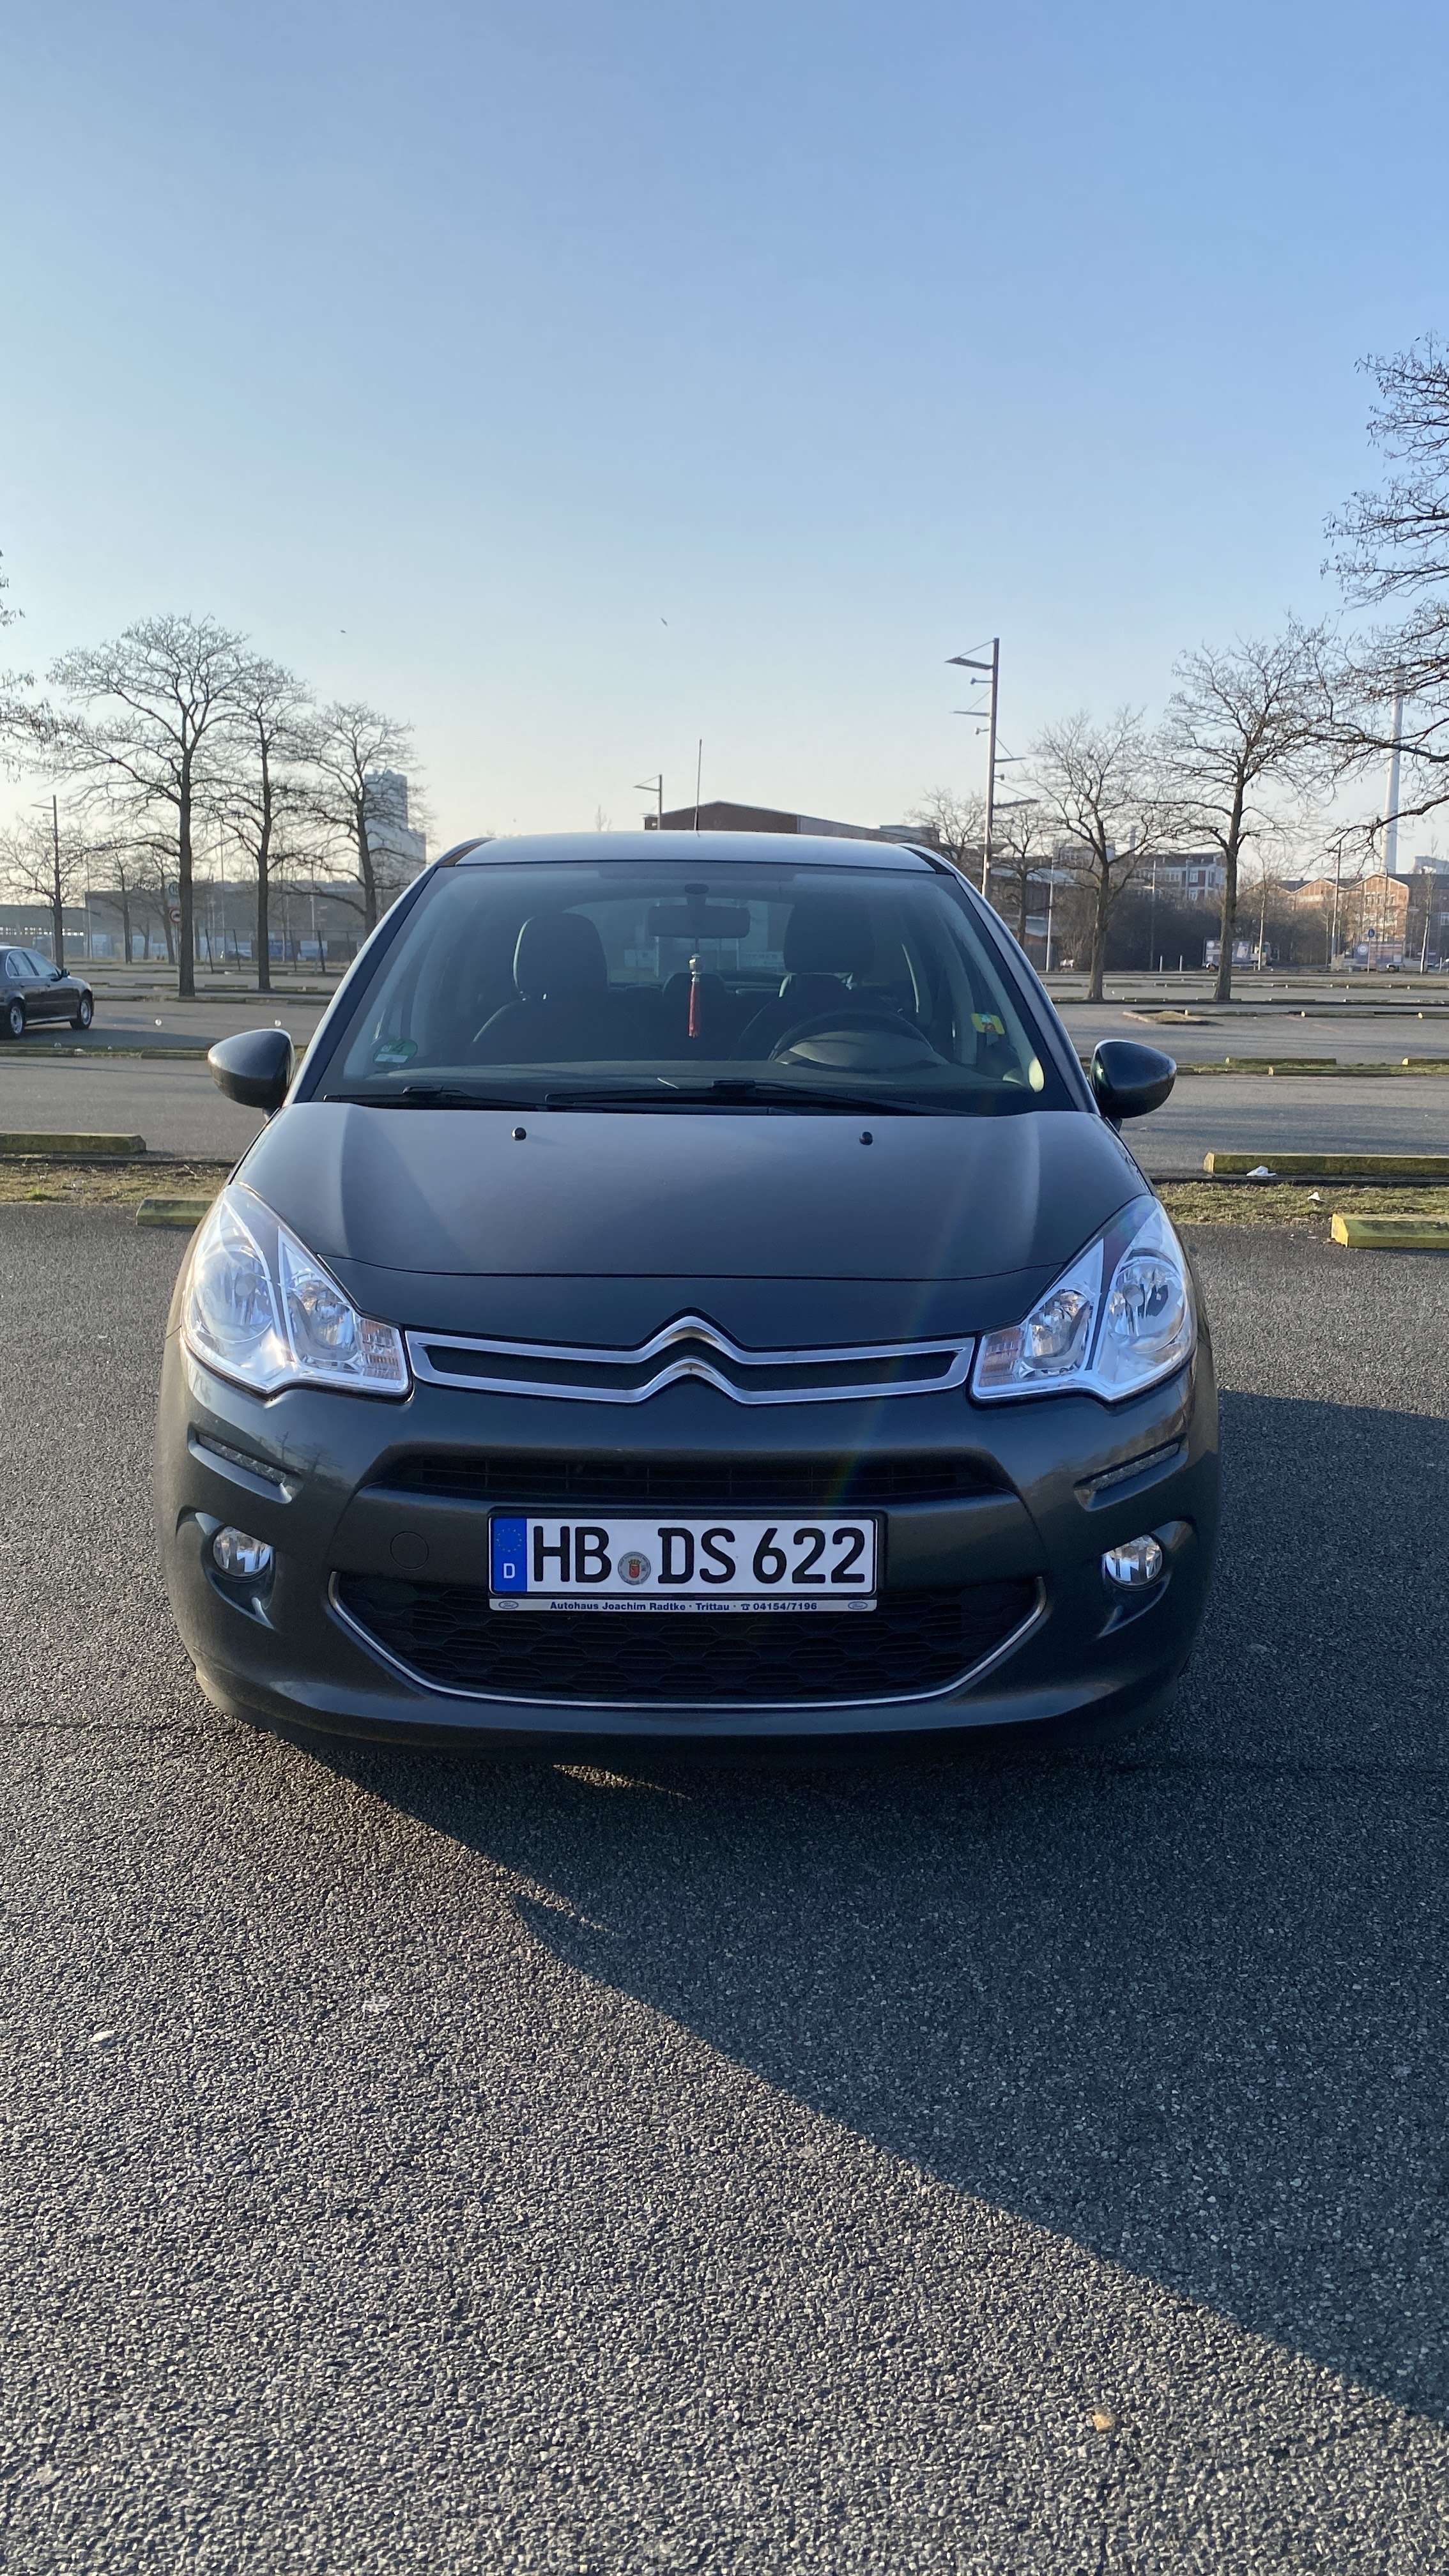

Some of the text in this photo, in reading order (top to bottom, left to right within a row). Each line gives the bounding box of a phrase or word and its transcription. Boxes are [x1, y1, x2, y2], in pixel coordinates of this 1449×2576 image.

[533, 1525, 612, 1584] HB
[657, 1527, 736, 1584] DS
[752, 1527, 866, 1584] 622
[503, 1563, 516, 1579] D
[550, 1601, 817, 1611] Autohaus Joachim Radtke Trittau 04154/7196
